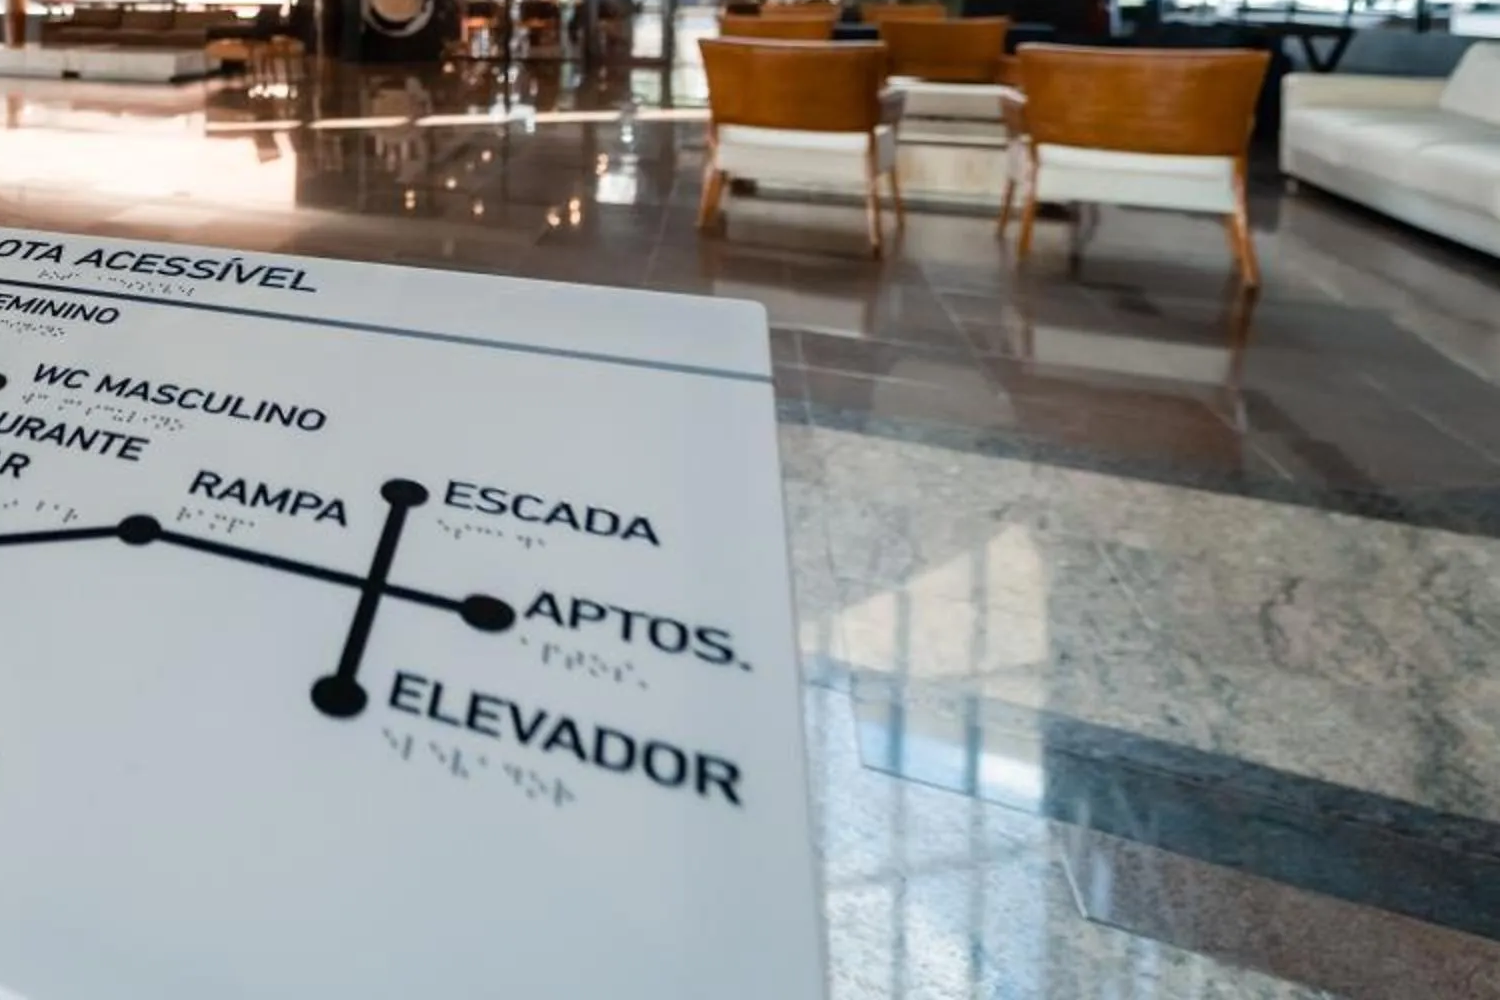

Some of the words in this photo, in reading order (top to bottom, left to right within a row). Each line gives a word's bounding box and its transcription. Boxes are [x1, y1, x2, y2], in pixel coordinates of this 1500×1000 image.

[75, 248, 318, 293] ACESSÍVEL
[33, 363, 90, 389] WC
[94, 374, 328, 433] MASCULINO
[188, 470, 349, 528] RAMPA
[443, 480, 661, 547] ESCADA
[523, 591, 754, 674] APTOS.
[387, 670, 743, 809] ELEVADOR
